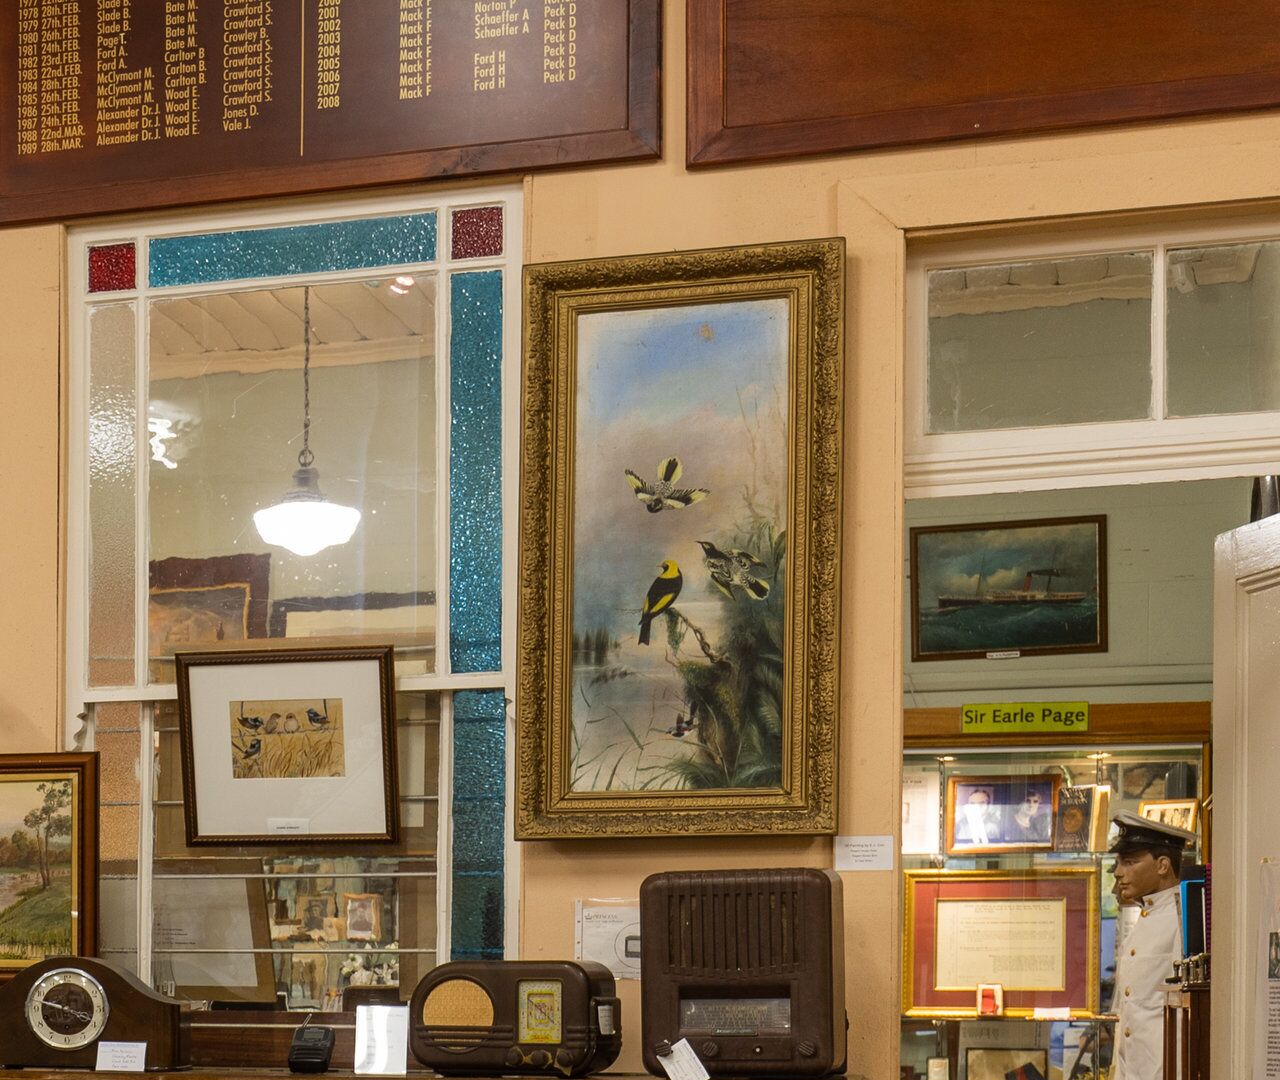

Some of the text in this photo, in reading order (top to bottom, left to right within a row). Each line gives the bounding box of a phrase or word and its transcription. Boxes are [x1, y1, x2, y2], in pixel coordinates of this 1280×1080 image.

[318, 68, 576, 110] 2008 Mack F Ford H Peck D
[964, 708, 1085, 726] Sir Earle Page
